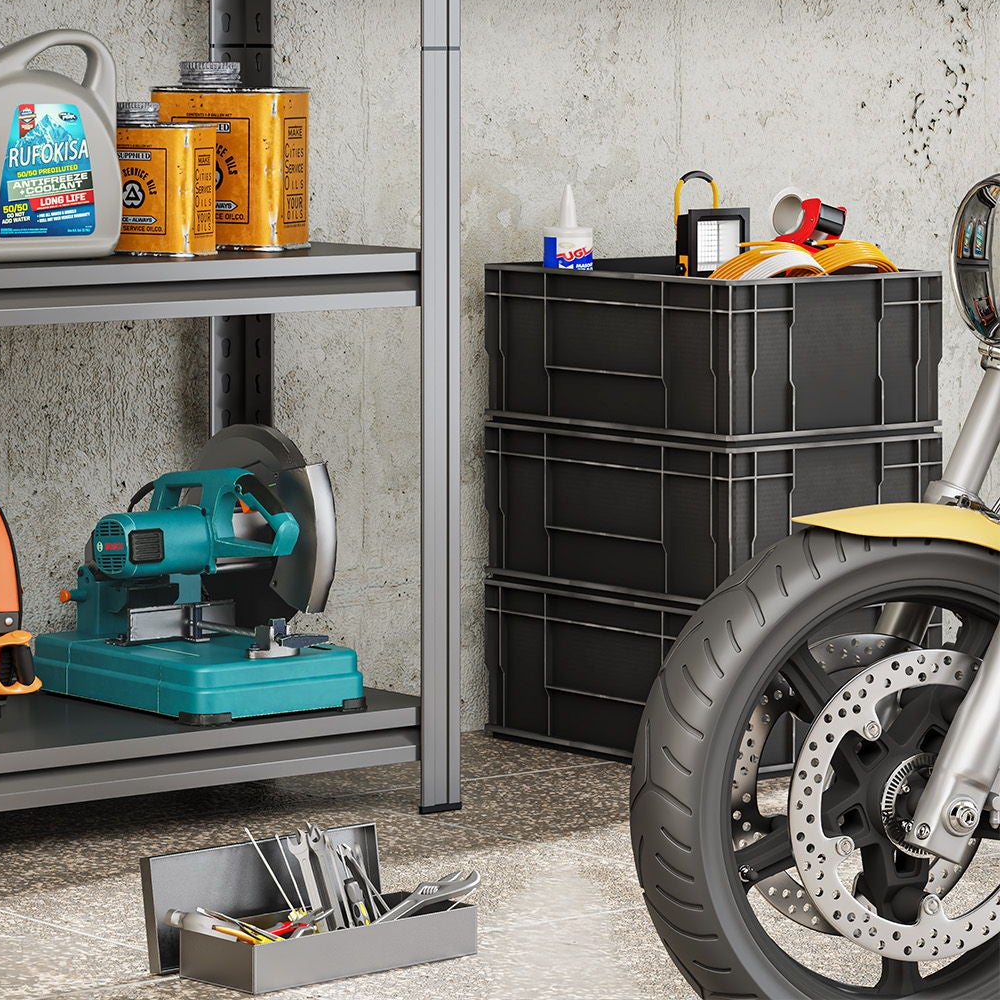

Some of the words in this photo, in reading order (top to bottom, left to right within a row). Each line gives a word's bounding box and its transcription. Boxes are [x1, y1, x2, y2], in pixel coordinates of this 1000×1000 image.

[288, 128, 303, 137] MAKE
[8, 139, 89, 168] RUFOKISA
[12, 172, 88, 189] ANTIFREEZE
[40, 195, 64, 206] LONG
[66, 192, 86, 203] LIFE
[287, 197, 303, 209] YOUR
[2, 203, 28, 213] 50/50
[287, 209, 303, 220] OILS
